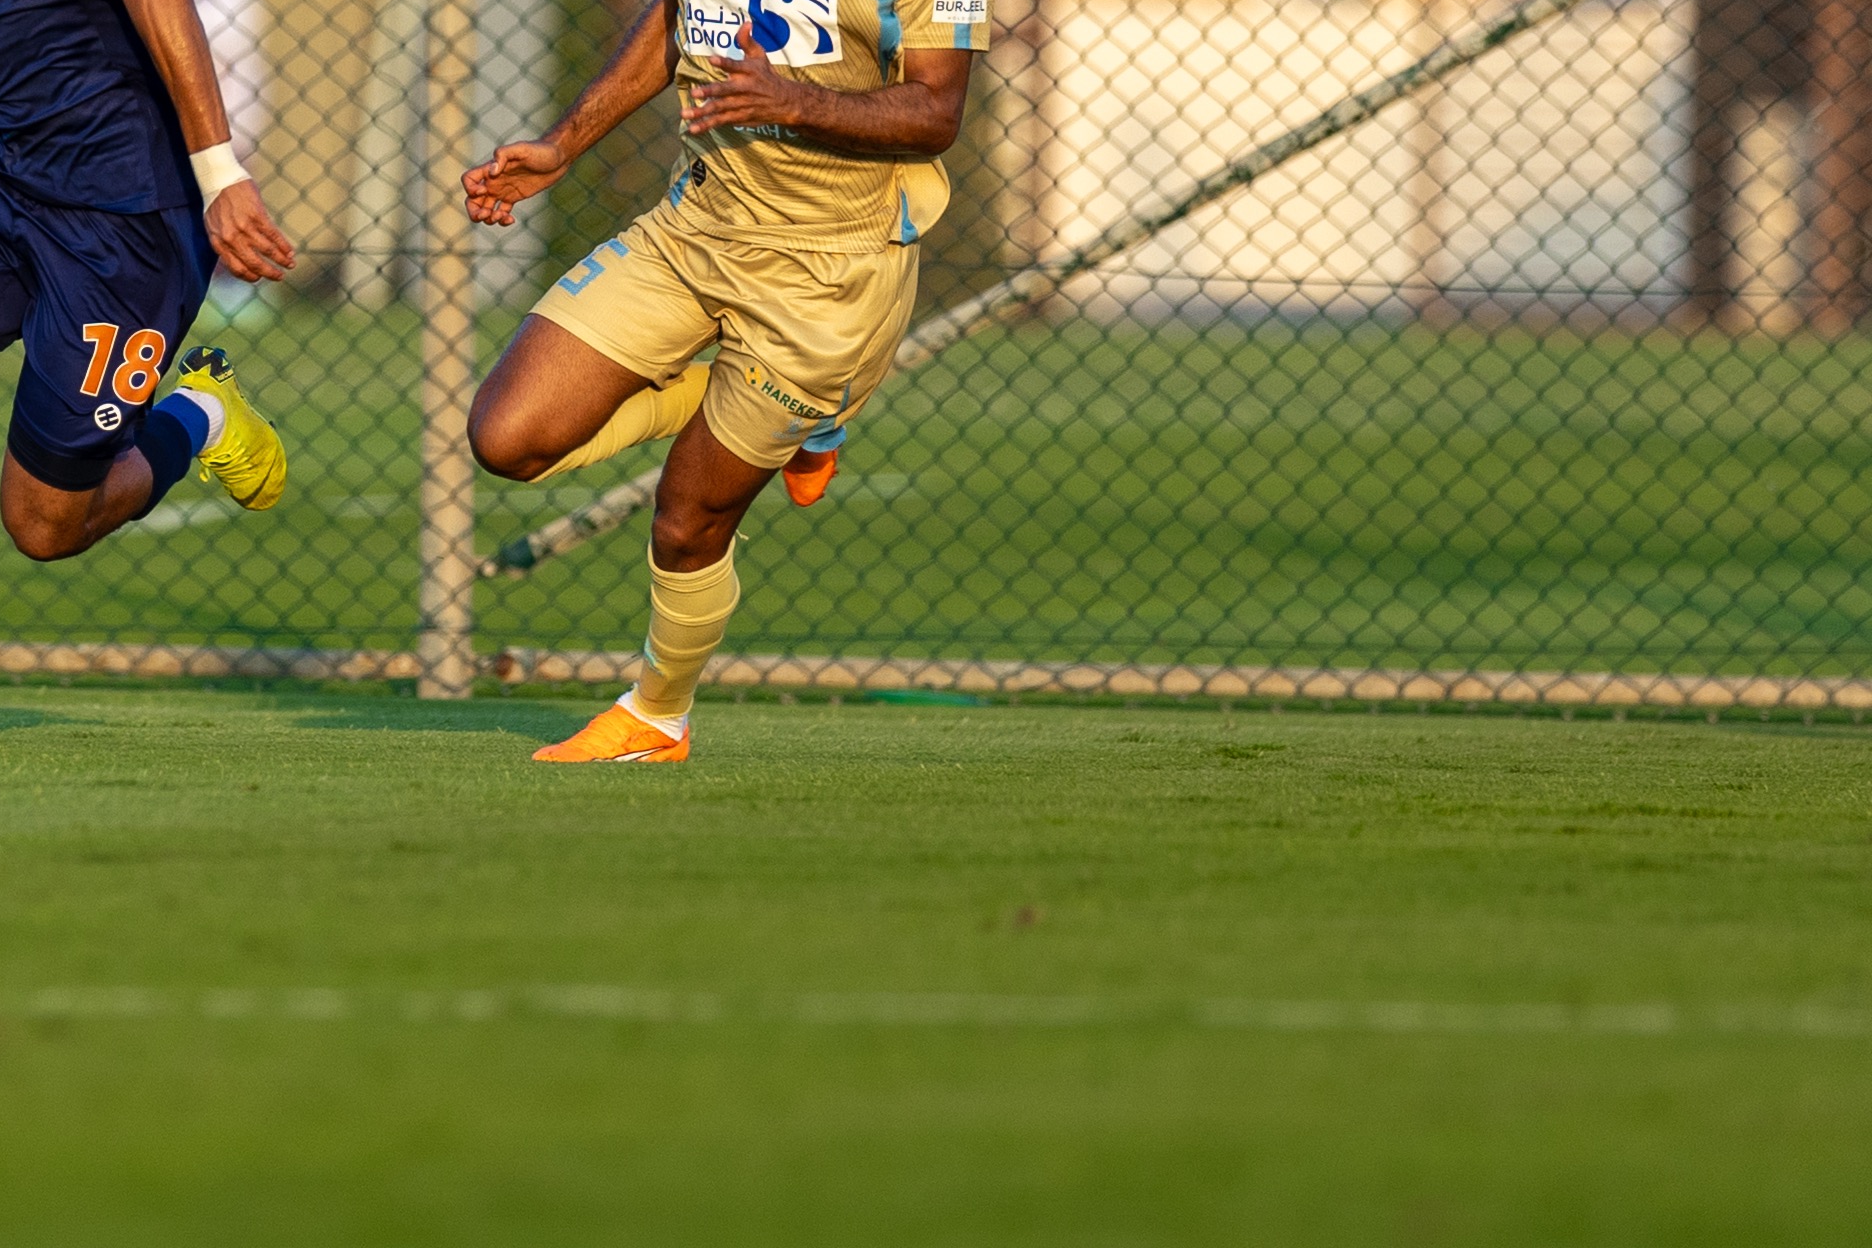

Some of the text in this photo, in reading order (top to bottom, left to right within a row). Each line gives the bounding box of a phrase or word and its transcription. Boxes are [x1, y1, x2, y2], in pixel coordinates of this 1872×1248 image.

[935, 0, 985, 12] BURJEEL
[687, 27, 742, 49] DNO
[80, 322, 167, 405] 18
